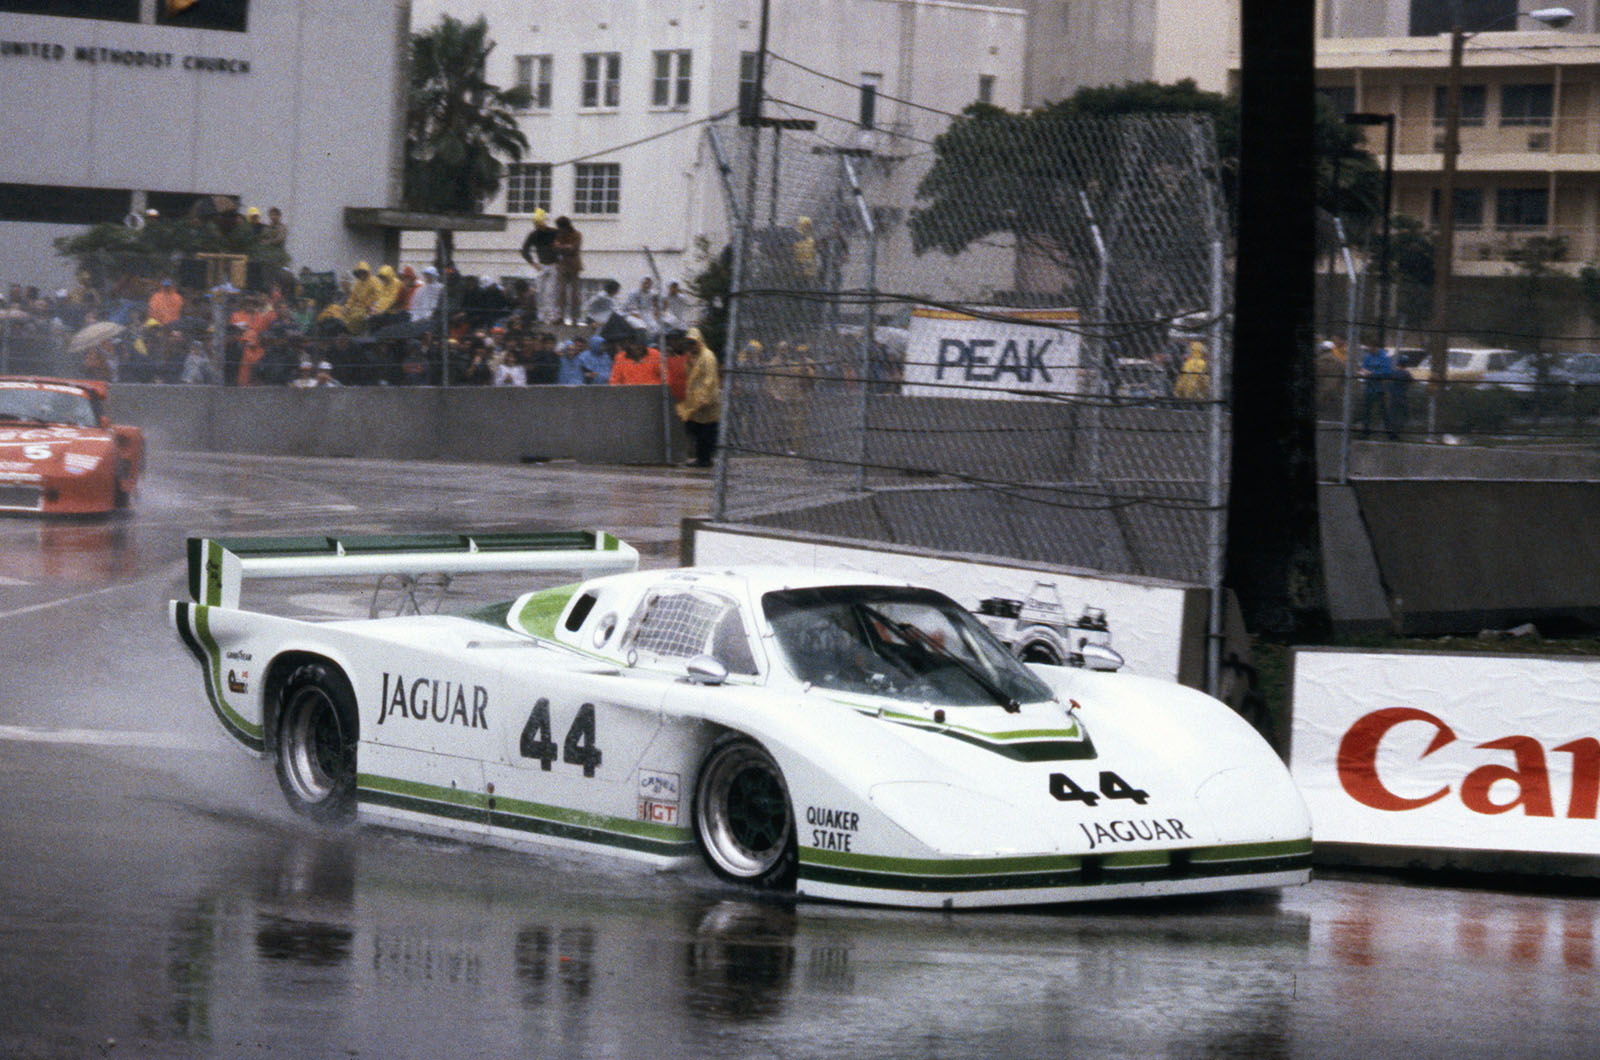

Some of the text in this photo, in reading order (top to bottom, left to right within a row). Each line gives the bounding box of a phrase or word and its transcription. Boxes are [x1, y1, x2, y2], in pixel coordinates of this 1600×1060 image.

[0, 41, 250, 73] UNITED METHODIST CHURCH
[936, 338, 1053, 383] PEAK
[377, 672, 488, 730] JAGUAR
[519, 697, 602, 778] 44
[1049, 771, 1150, 807] 44
[652, 803, 677, 822] GT
[806, 806, 860, 832] QUAKER
[812, 829, 852, 852] STATE
[1079, 818, 1193, 849] JAGUAR
